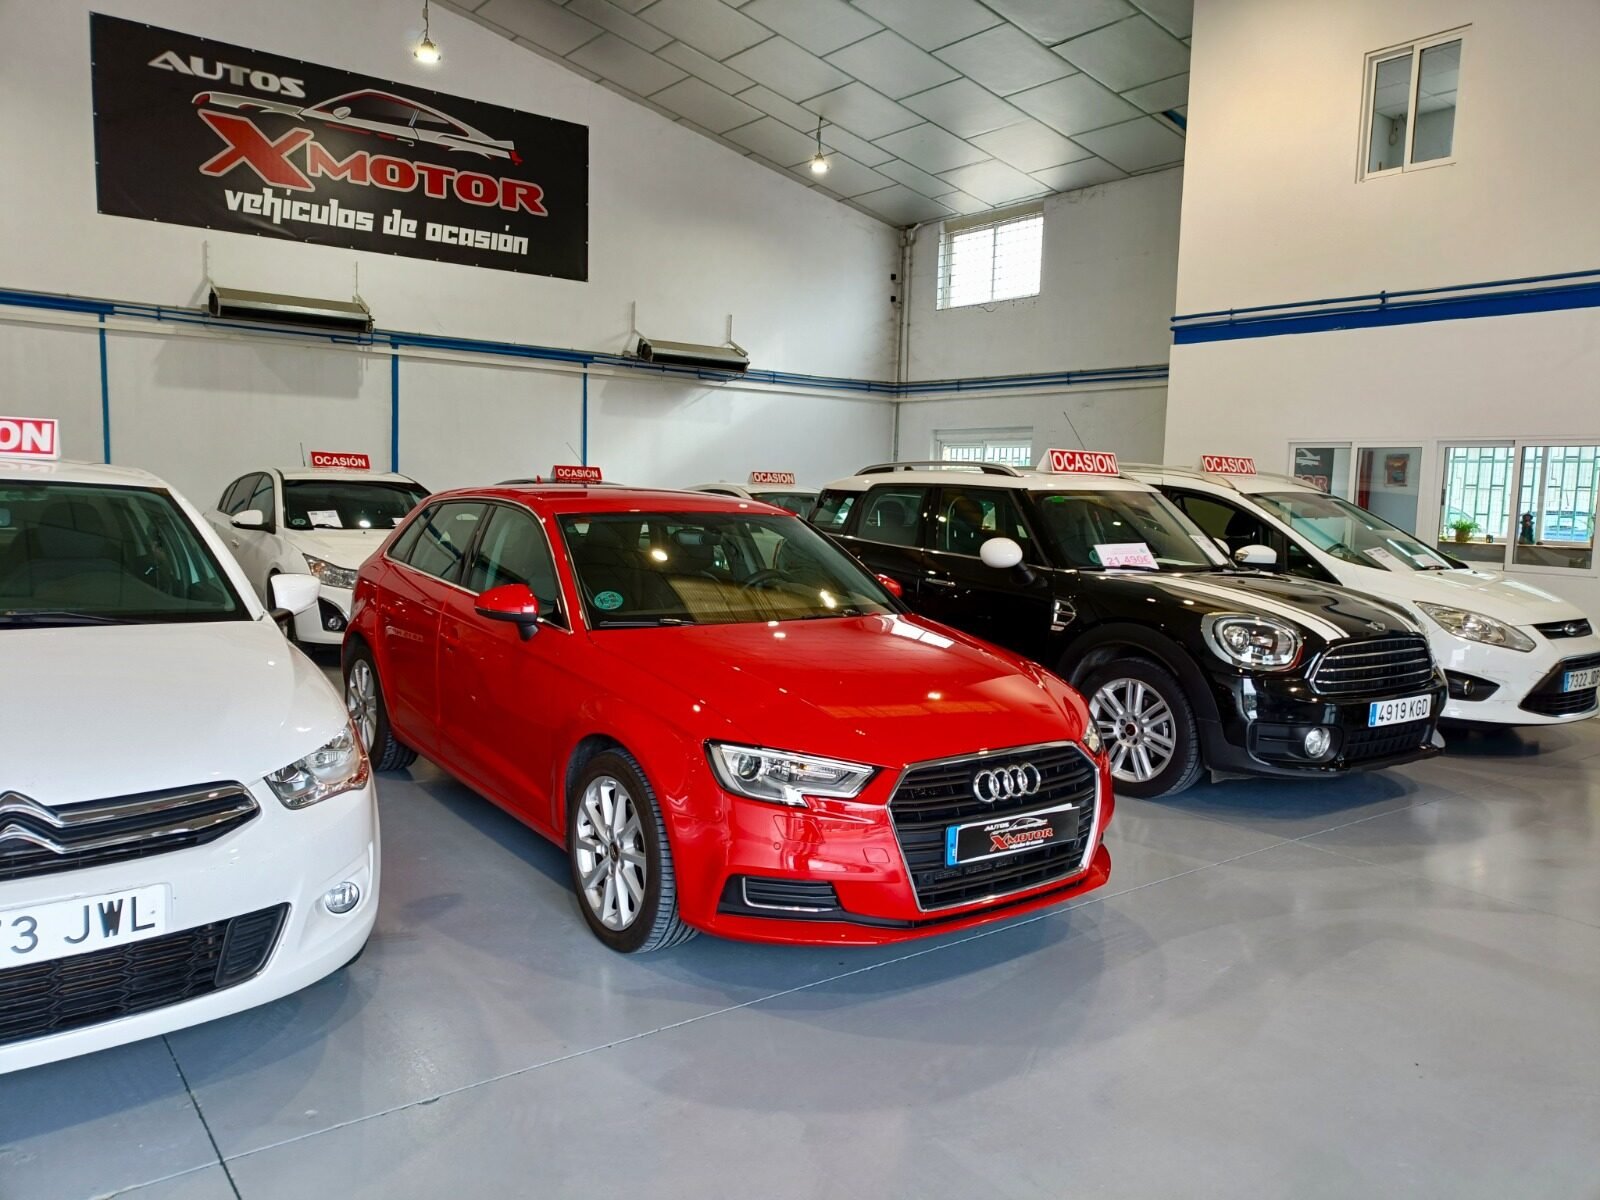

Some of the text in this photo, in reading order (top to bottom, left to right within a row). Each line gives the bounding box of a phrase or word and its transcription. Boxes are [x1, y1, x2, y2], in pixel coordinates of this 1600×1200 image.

[148, 50, 306, 98] AUTOS
[198, 108, 549, 217] XMOTOR
[382, 208, 418, 239] de
[425, 221, 528, 255] ocasión
[1052, 452, 1118, 473] OCASION
[1204, 456, 1255, 474] OCASION
[1379, 698, 1428, 722] 4919 KGD
[63, 896, 156, 944] JWL
